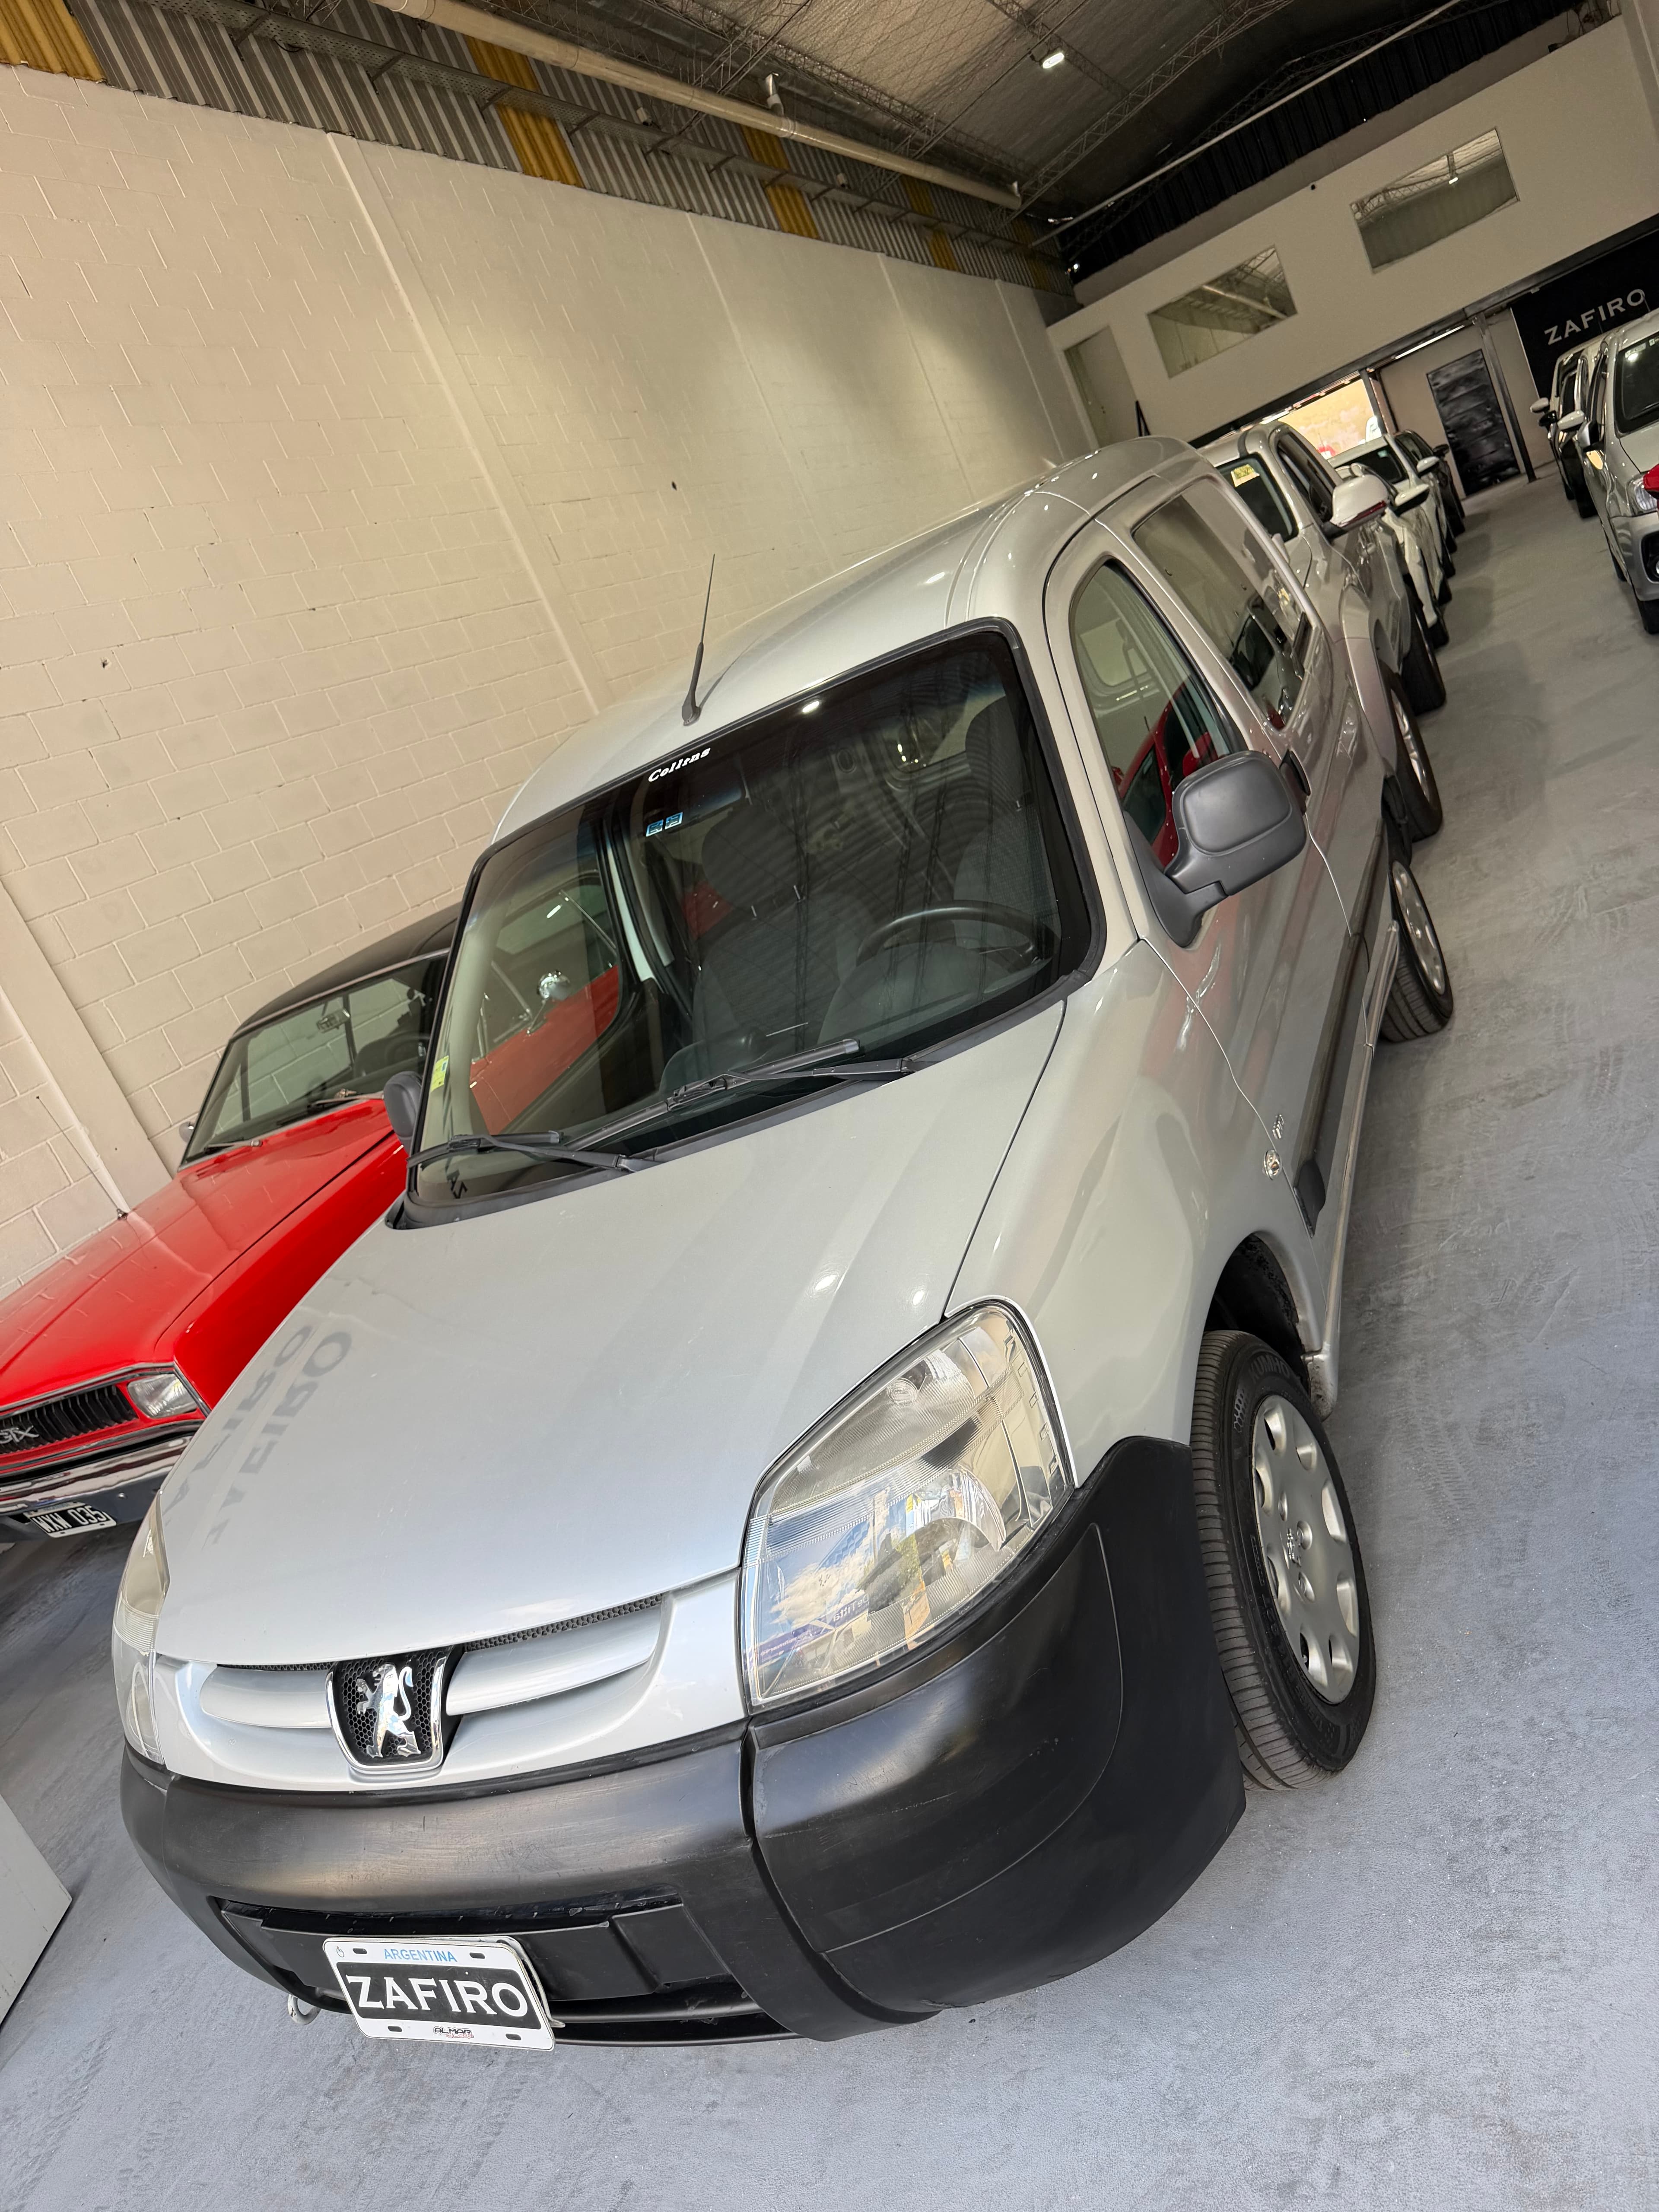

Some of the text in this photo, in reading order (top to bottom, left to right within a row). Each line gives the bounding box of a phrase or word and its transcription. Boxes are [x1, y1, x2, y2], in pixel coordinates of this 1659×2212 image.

[1544, 289, 1645, 345] ZAFIRO
[1248, 1354, 1290, 1385] KUMHO
[32, 1506, 107, 1532] WXW 035
[385, 1949, 458, 1962] ARGENTINA
[346, 1975, 528, 2017] ZAFIRO
